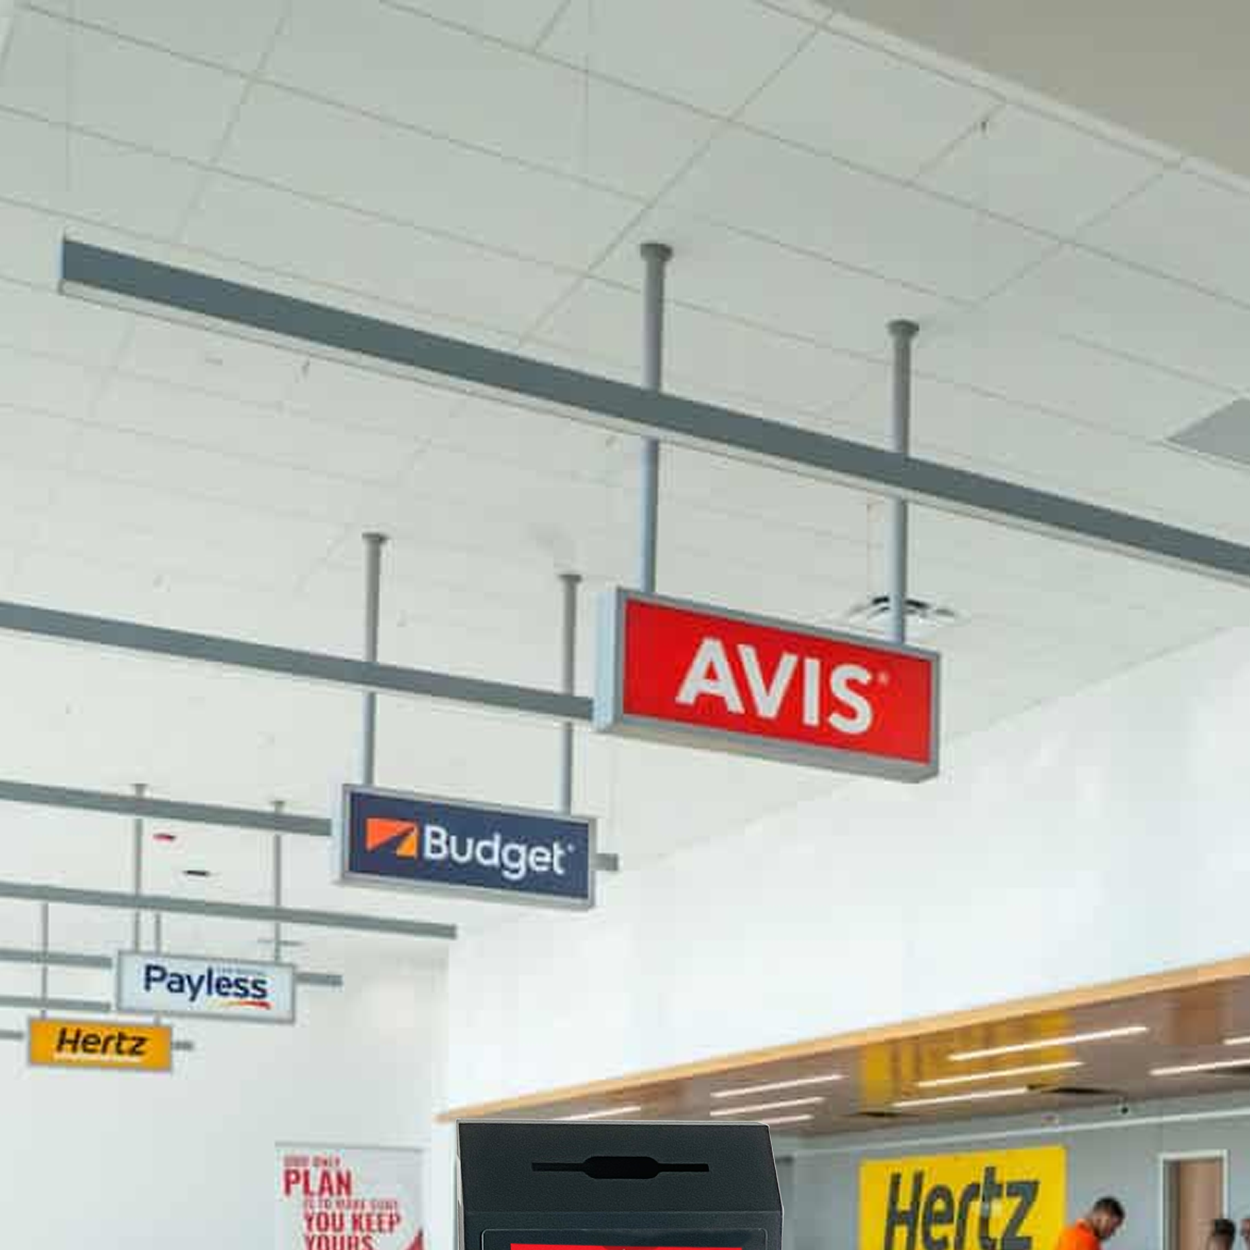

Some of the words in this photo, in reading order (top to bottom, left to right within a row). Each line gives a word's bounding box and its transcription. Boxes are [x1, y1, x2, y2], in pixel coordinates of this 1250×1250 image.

[675, 636, 873, 734] AVIS
[424, 824, 565, 880] Budget
[143, 963, 269, 1001] Payless
[56, 1027, 148, 1056] Hertz
[284, 1168, 351, 1196] PLAN
[304, 1211, 344, 1233] YOU
[351, 1212, 401, 1235] KEEP
